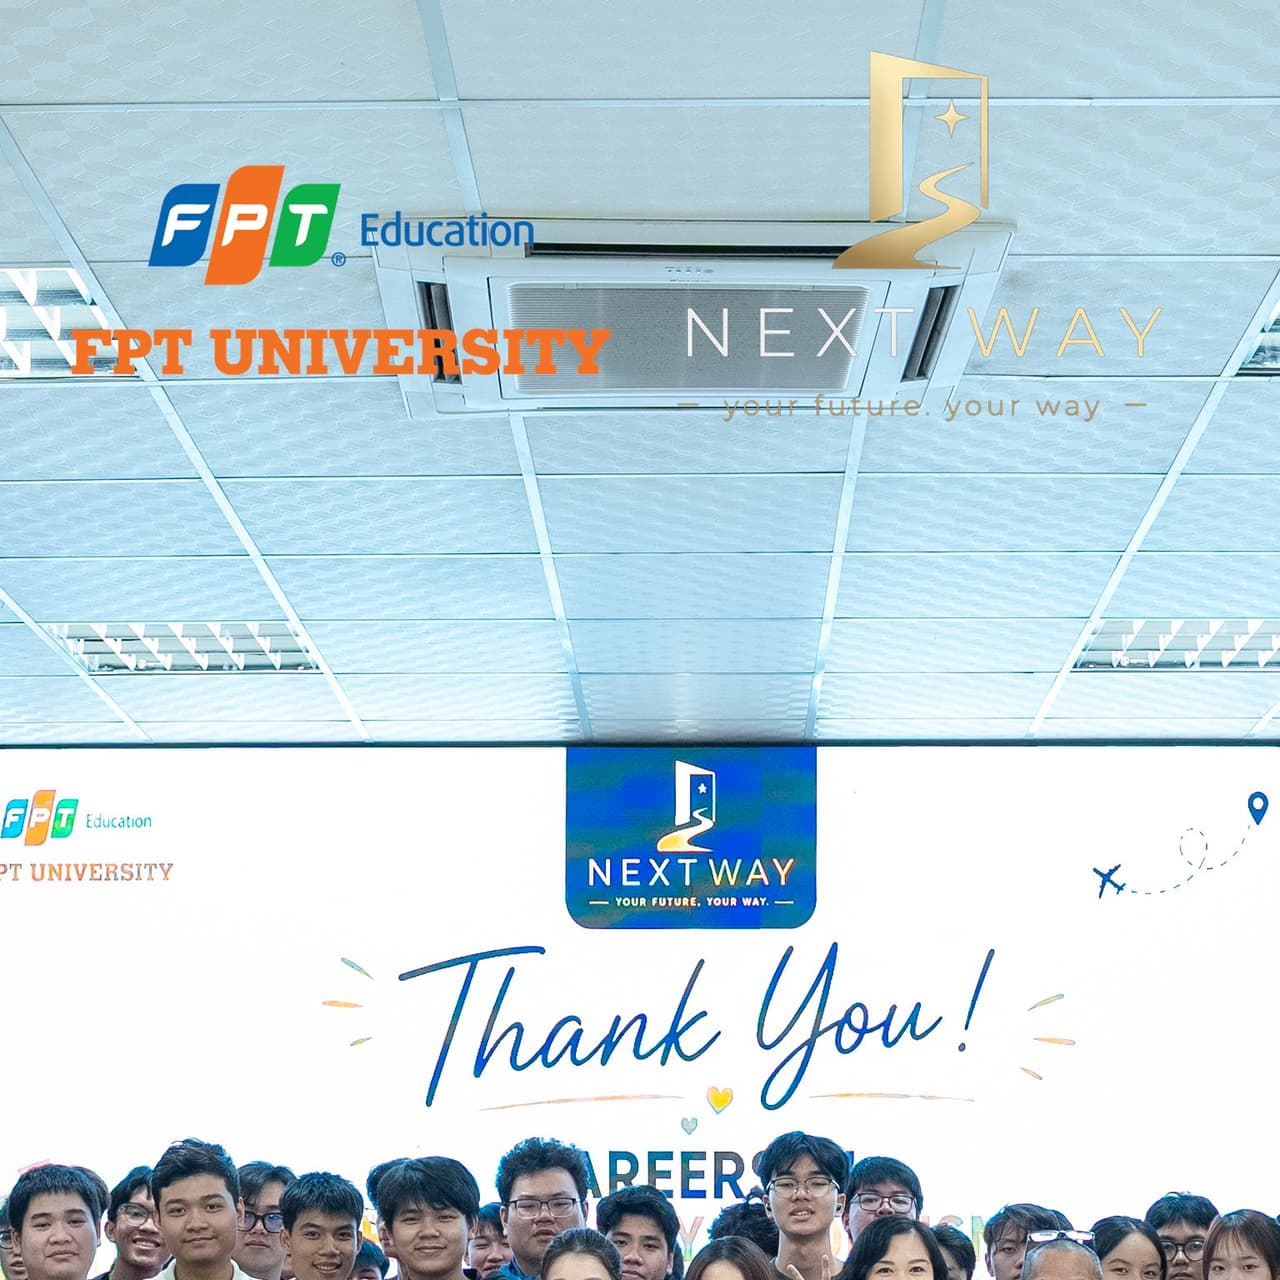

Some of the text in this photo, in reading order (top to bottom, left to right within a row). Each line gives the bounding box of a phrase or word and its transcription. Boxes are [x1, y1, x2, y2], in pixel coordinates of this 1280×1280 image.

[86, 813, 152, 829] Education
[30, 862, 174, 882] UNIVERSITY
[588, 858, 795, 887] NEXT WAY
[615, 897, 647, 908] YOUR
[706, 896, 737, 908] YOUR
[398, 945, 722, 1109] Thank
